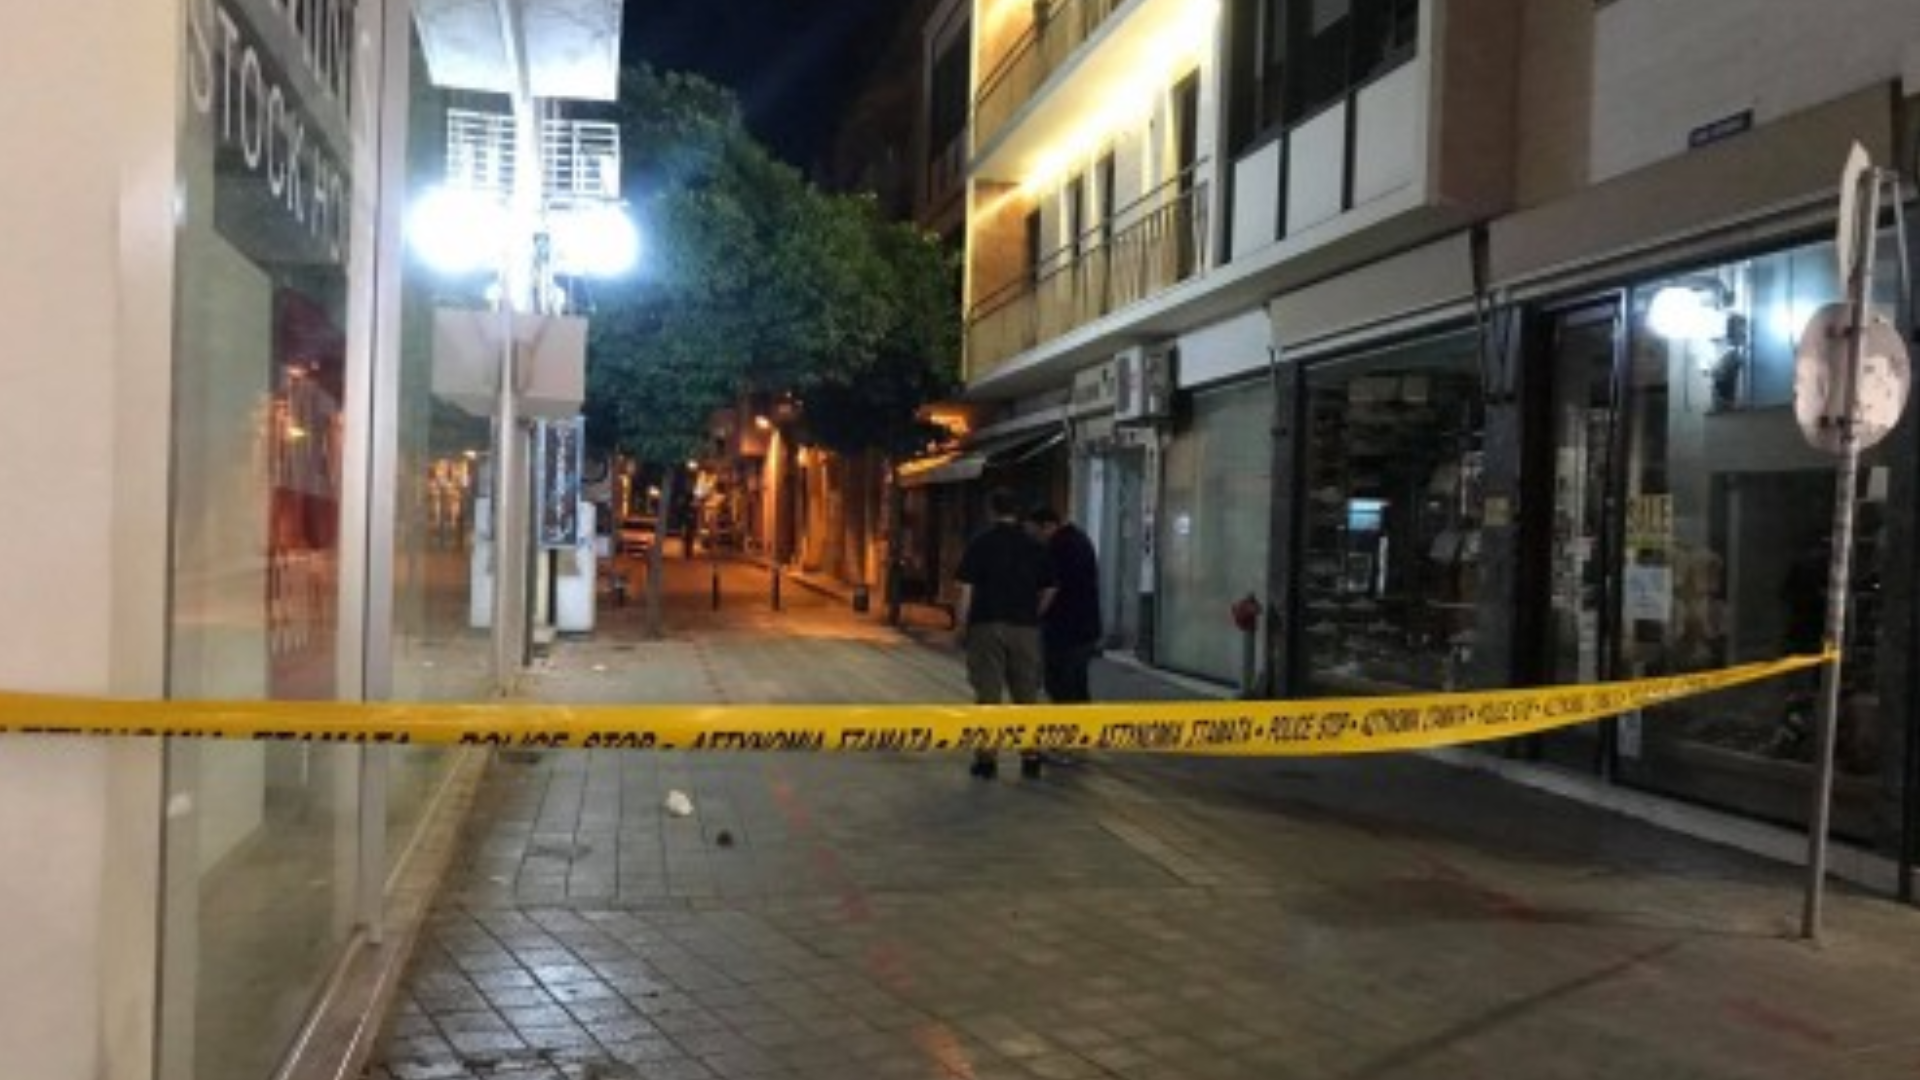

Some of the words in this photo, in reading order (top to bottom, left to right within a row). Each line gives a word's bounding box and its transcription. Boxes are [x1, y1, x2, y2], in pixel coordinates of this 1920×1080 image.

[189, 2, 304, 223] STOCK
[1270, 713, 1314, 743] POLICE
[1316, 711, 1349, 740] STOP
